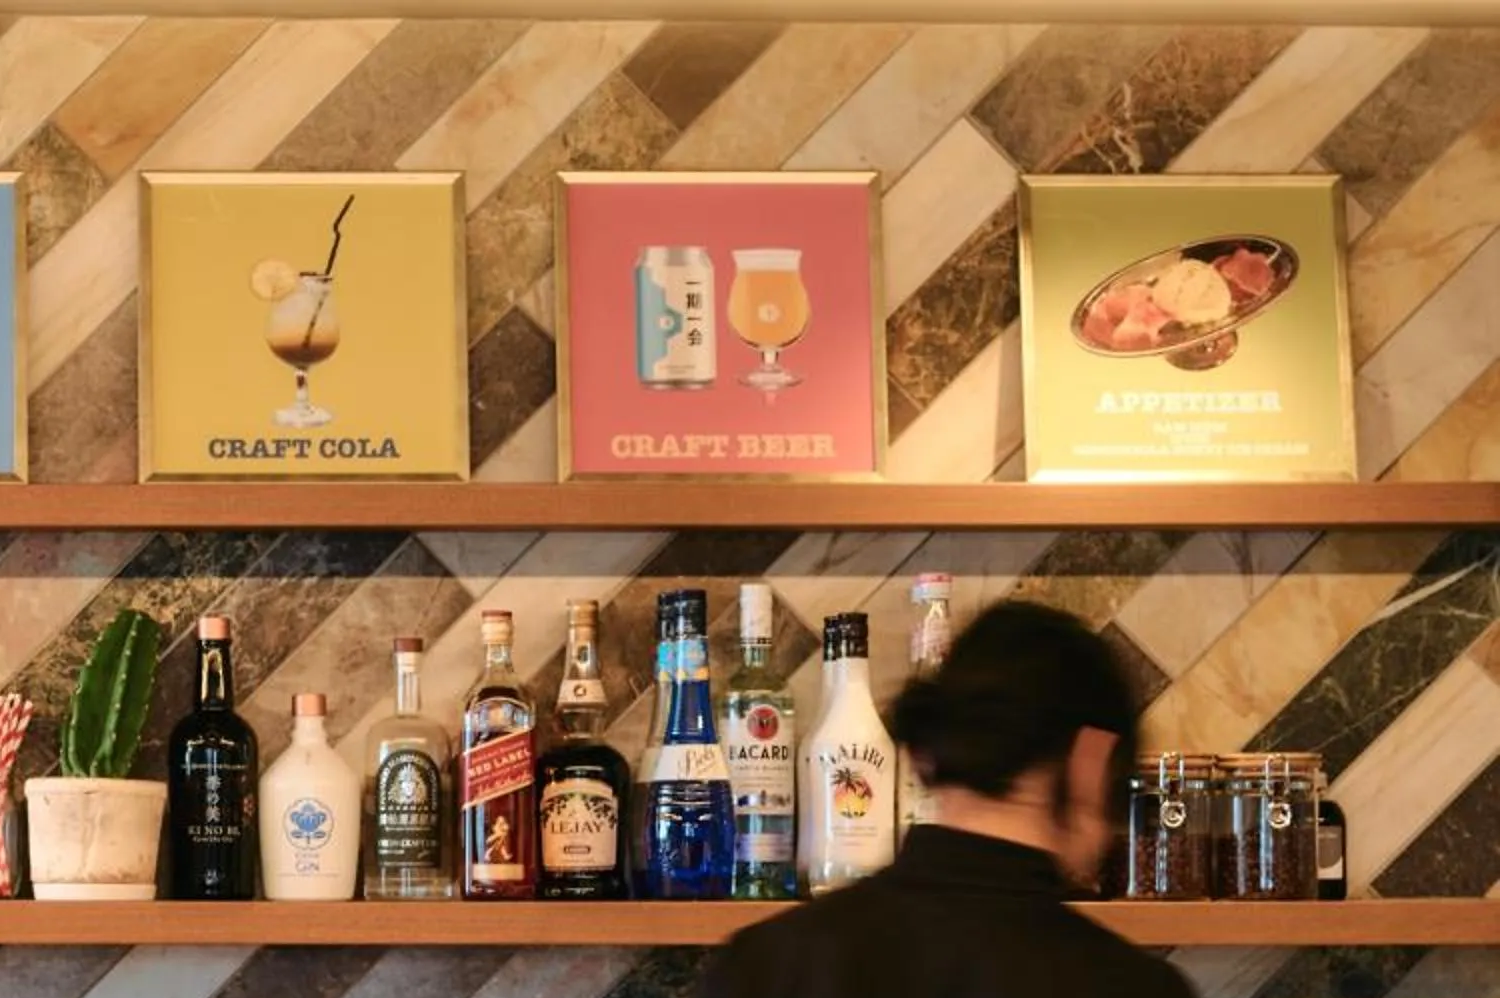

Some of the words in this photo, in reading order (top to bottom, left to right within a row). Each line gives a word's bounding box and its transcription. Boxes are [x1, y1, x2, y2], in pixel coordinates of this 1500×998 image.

[1094, 390, 1283, 413] APPETIZER
[208, 438, 312, 459] CRAFT
[318, 438, 401, 459] COLA
[610, 434, 730, 458] CRAFT
[736, 434, 835, 458] BEER
[551, 821, 604, 835] LEJAY
